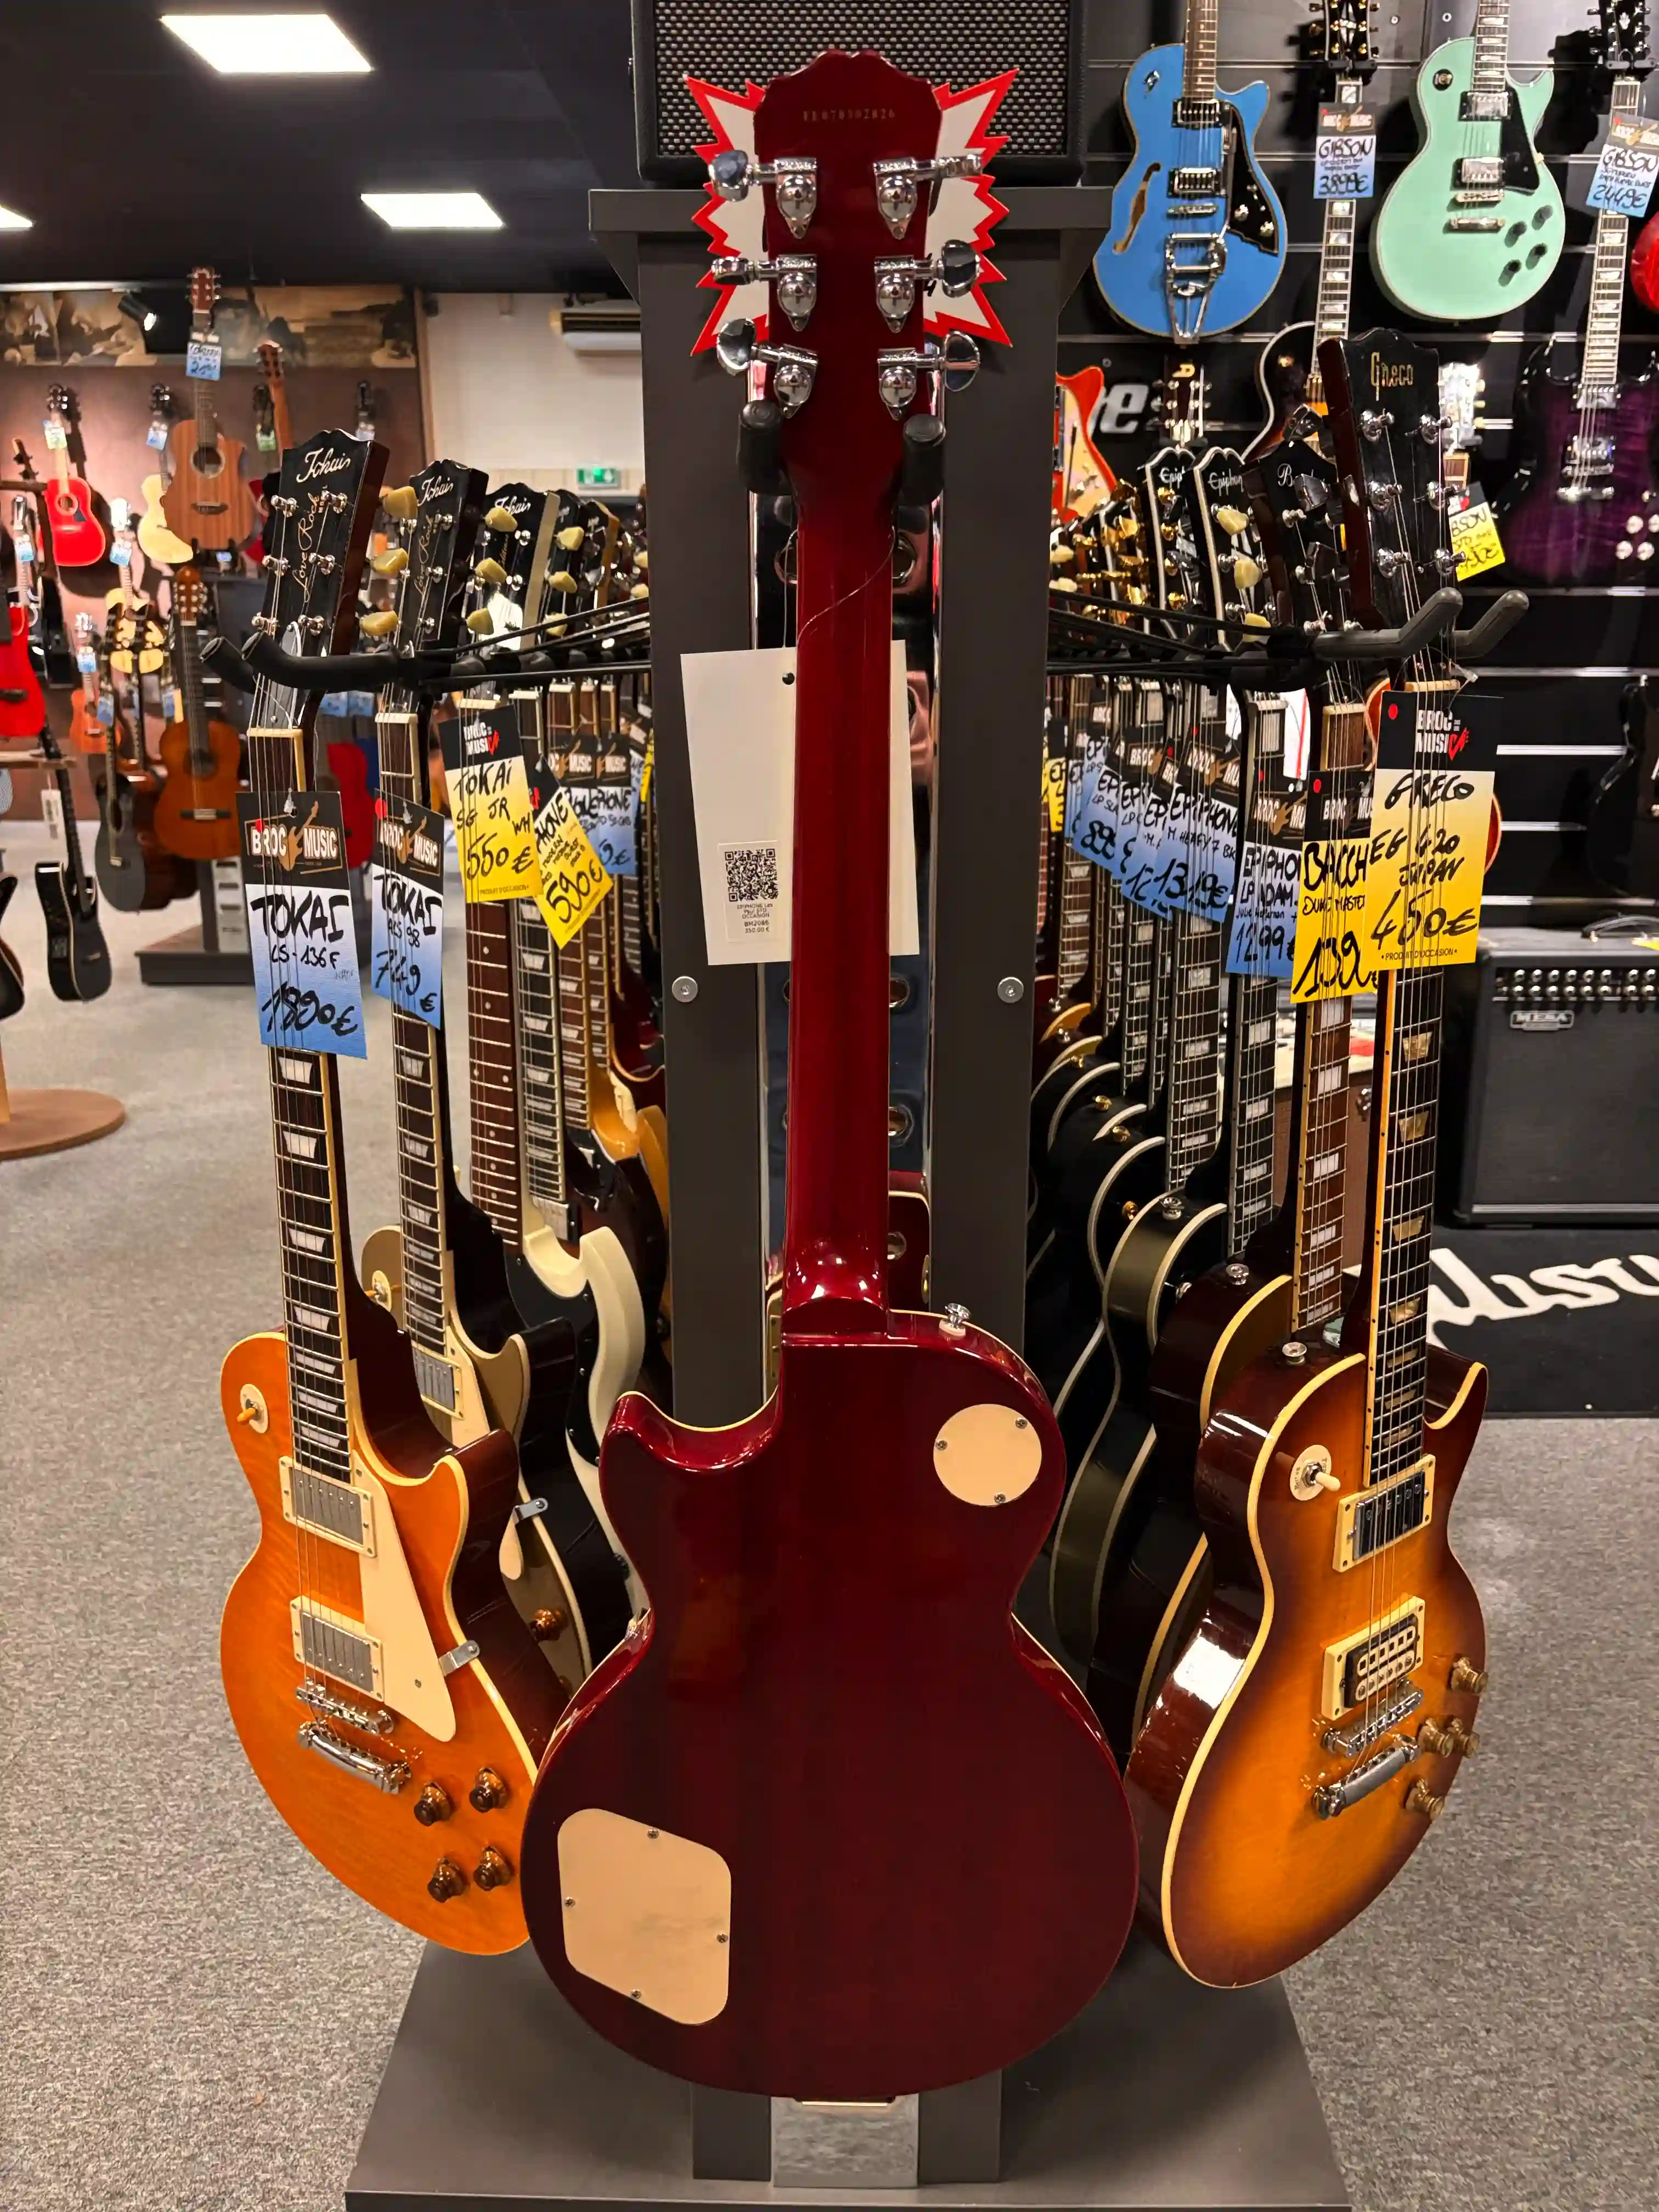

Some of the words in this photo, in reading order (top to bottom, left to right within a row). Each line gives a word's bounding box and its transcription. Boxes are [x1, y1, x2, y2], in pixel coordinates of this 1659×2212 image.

[1319, 138, 1373, 159] GIBSON
[1603, 148, 1657, 173] GIBSON
[1208, 469, 1244, 496] Epiphon
[1451, 507, 1487, 538] BSON
[1417, 710, 1453, 731] BROC
[1222, 762, 1240, 786] MU
[1384, 772, 1475, 810] GRECO
[487, 796, 511, 822] JR
[1290, 803, 1306, 830] MU
[252, 825, 288, 857] BROC
[303, 827, 338, 860] MUSIC
[413, 834, 438, 867] MUSIC
[1304, 842, 1369, 892] BACCH
[1399, 857, 1465, 887] JAPAN
[374, 873, 442, 936] TOKAI
[546, 858, 603, 924] 590€
[1240, 880, 1255, 904] LP
[250, 890, 349, 944] TOKAI
[1370, 889, 1478, 950] 450€
